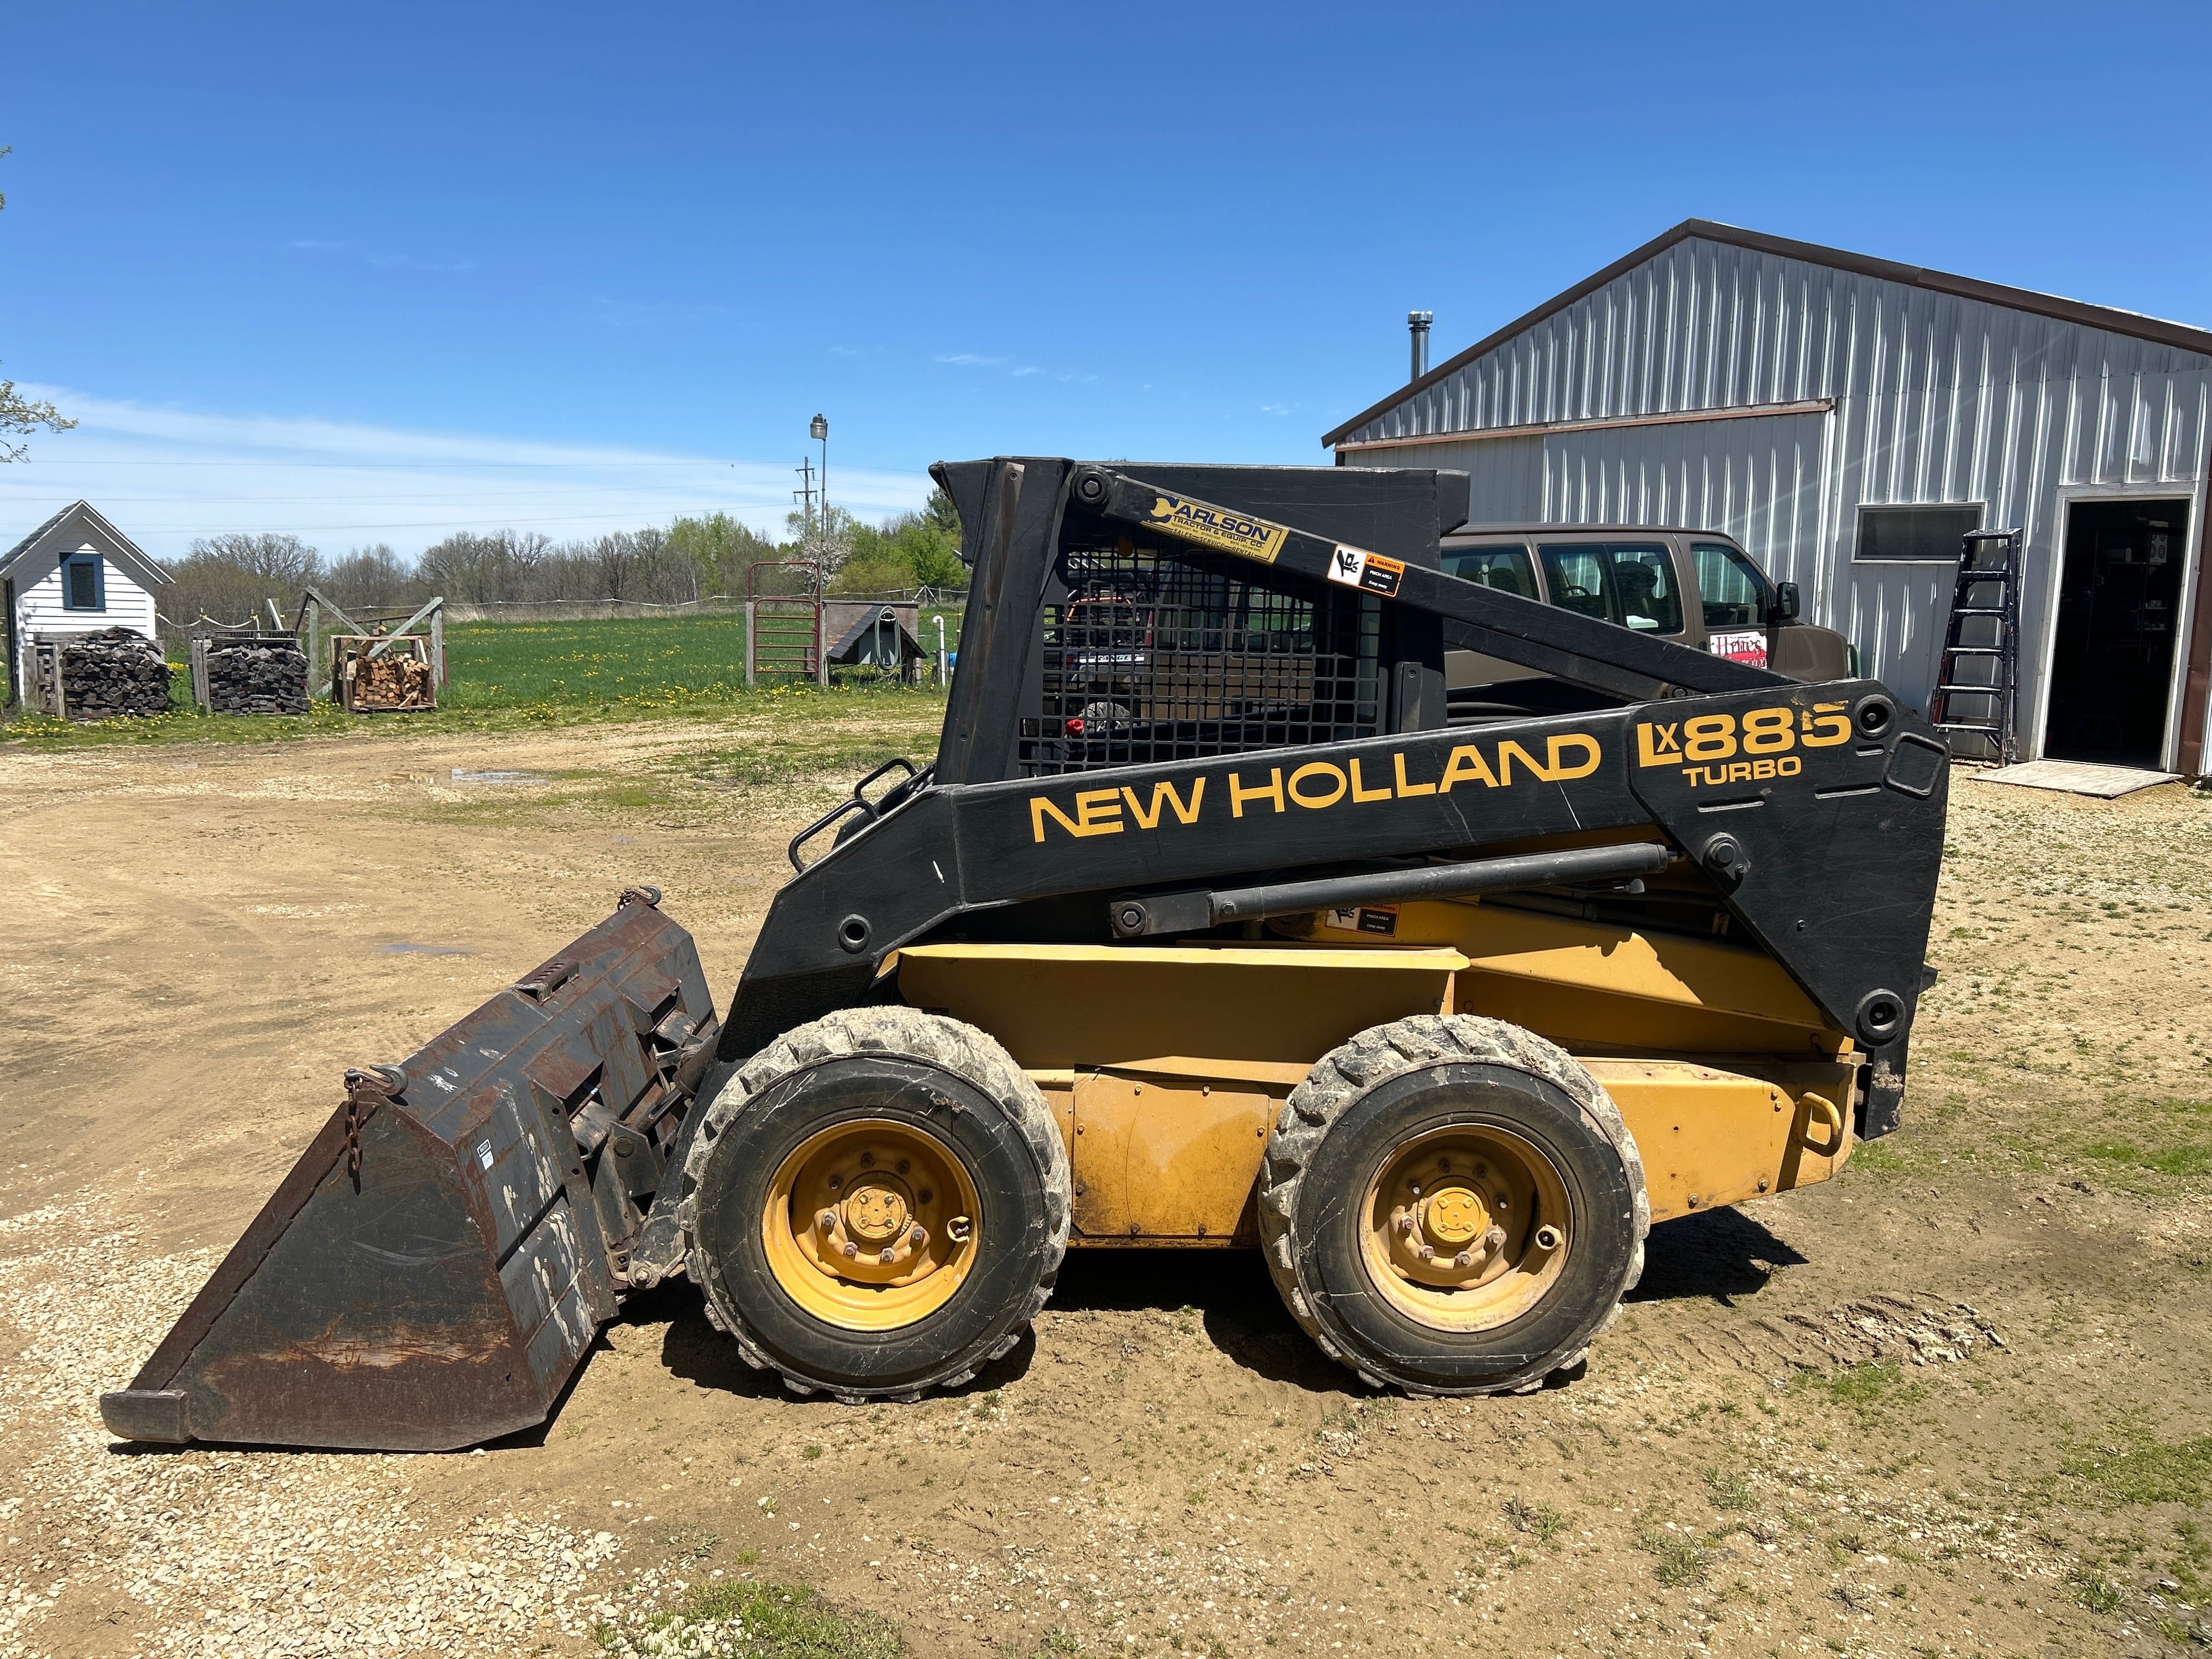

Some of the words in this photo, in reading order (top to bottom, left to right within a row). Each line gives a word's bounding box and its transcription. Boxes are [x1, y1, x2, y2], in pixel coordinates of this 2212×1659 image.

[1147, 493, 1271, 541] CARLSON
[1172, 515, 1212, 532] TRACTOR
[1222, 531, 1248, 544] EQUIP.
[1250, 540, 1264, 549] CO.
[1377, 560, 1400, 570] WARNING
[1030, 778, 1206, 842] NEW
[1229, 733, 1601, 817] HOLLAND
[1682, 756, 1801, 787] TURBO
